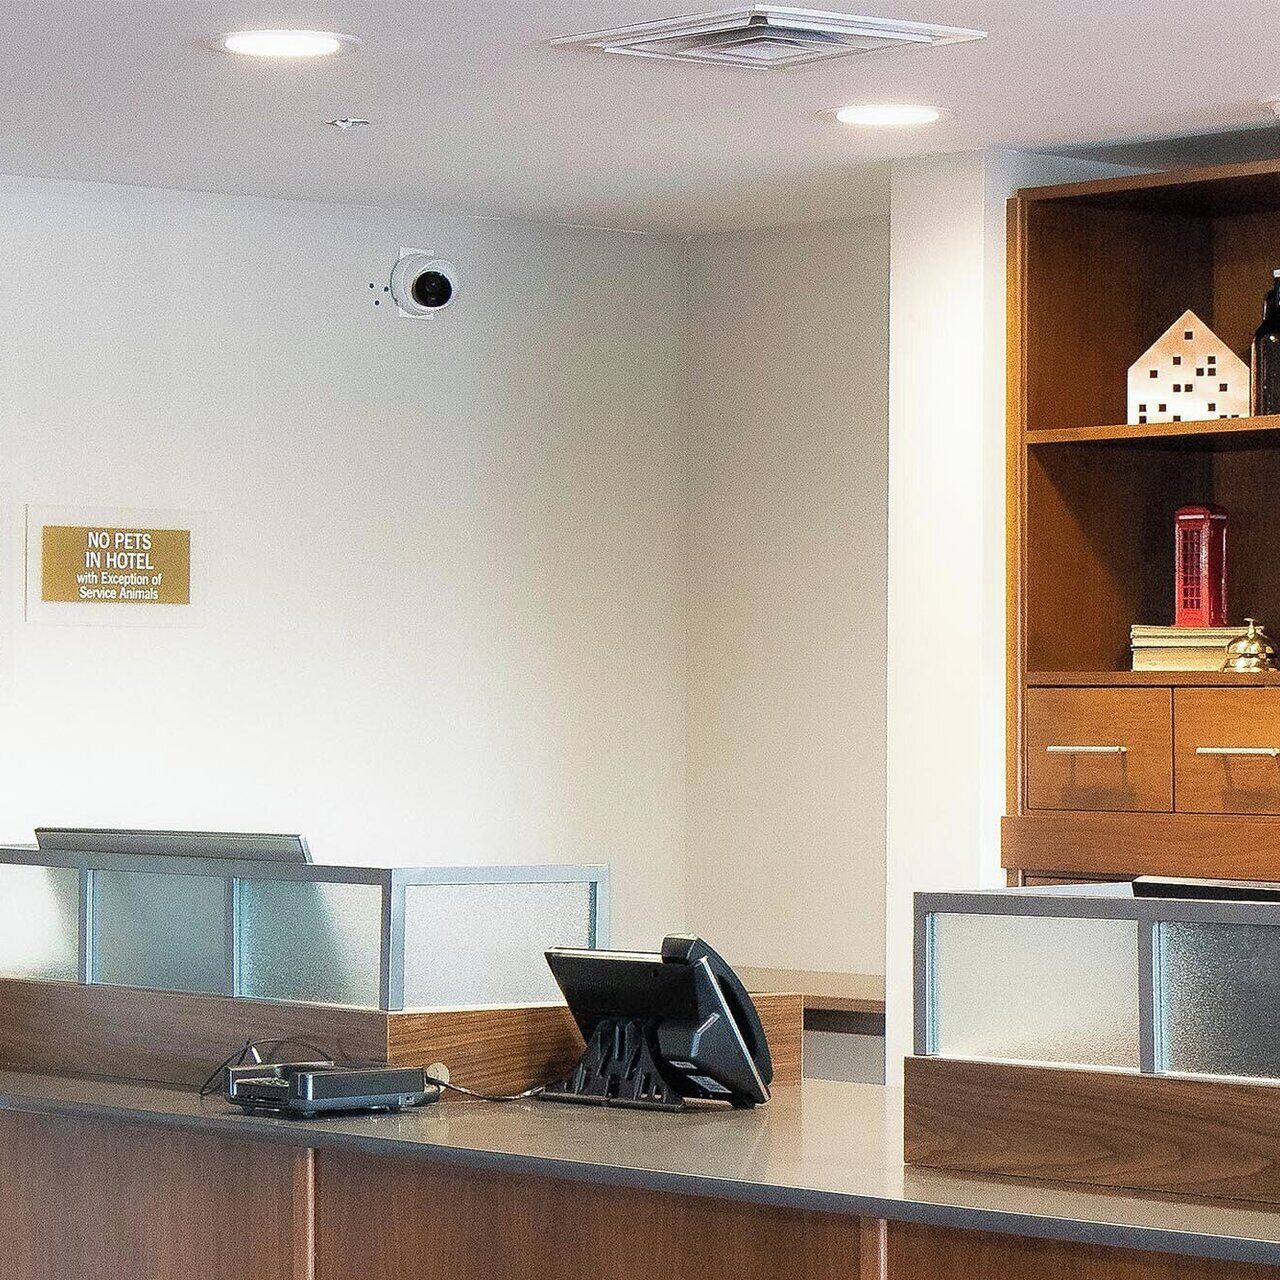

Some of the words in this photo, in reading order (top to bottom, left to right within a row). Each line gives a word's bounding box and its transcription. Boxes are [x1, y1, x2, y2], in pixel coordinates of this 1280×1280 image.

[88, 531, 110, 549] NO
[114, 532, 151, 550] PETS
[86, 551, 101, 568] IN
[106, 552, 154, 570] HOTEL
[76, 572, 98, 584] with
[100, 571, 149, 587] Exception
[151, 573, 162, 586] of
[79, 586, 117, 599] Service
[119, 587, 158, 600] Animals
